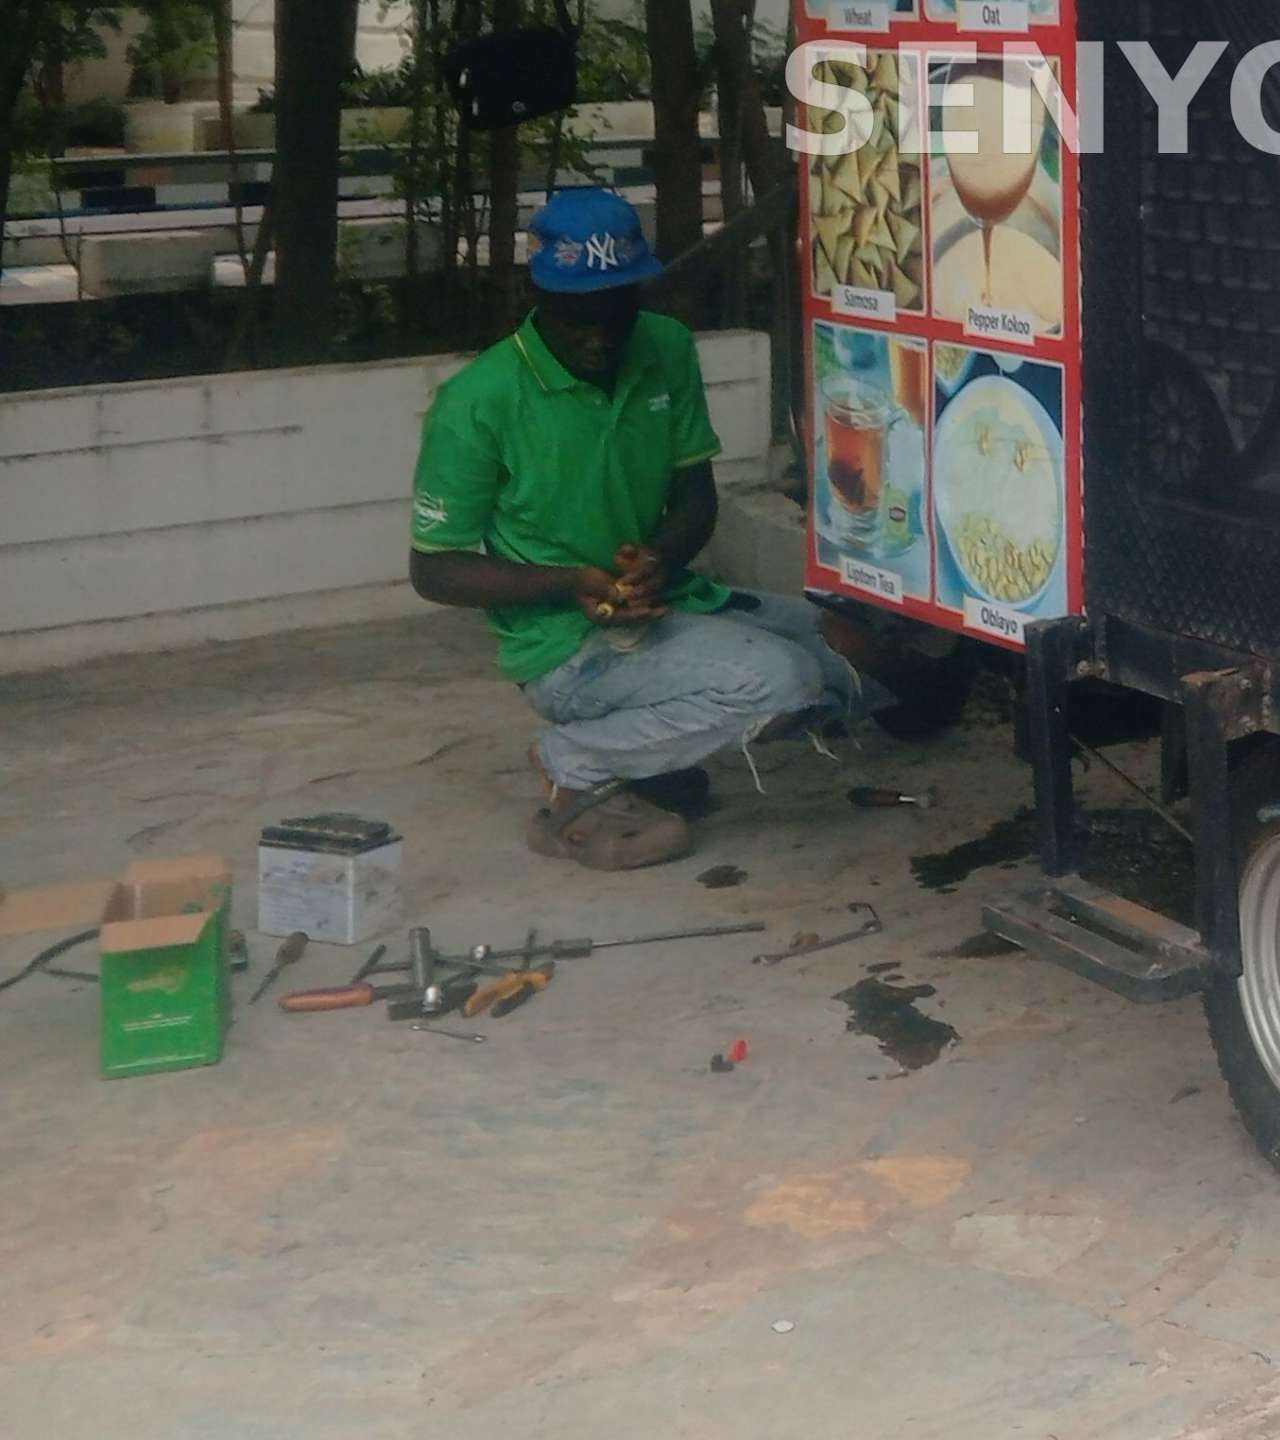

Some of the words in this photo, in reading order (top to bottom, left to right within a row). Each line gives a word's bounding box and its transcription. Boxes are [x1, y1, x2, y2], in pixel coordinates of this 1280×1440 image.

[982, 4, 1001, 25] Oat
[844, 288, 878, 311] Samosa
[968, 307, 1000, 332] Pepper
[1002, 312, 1030, 336] Kokoo
[878, 573, 896, 595] Tea
